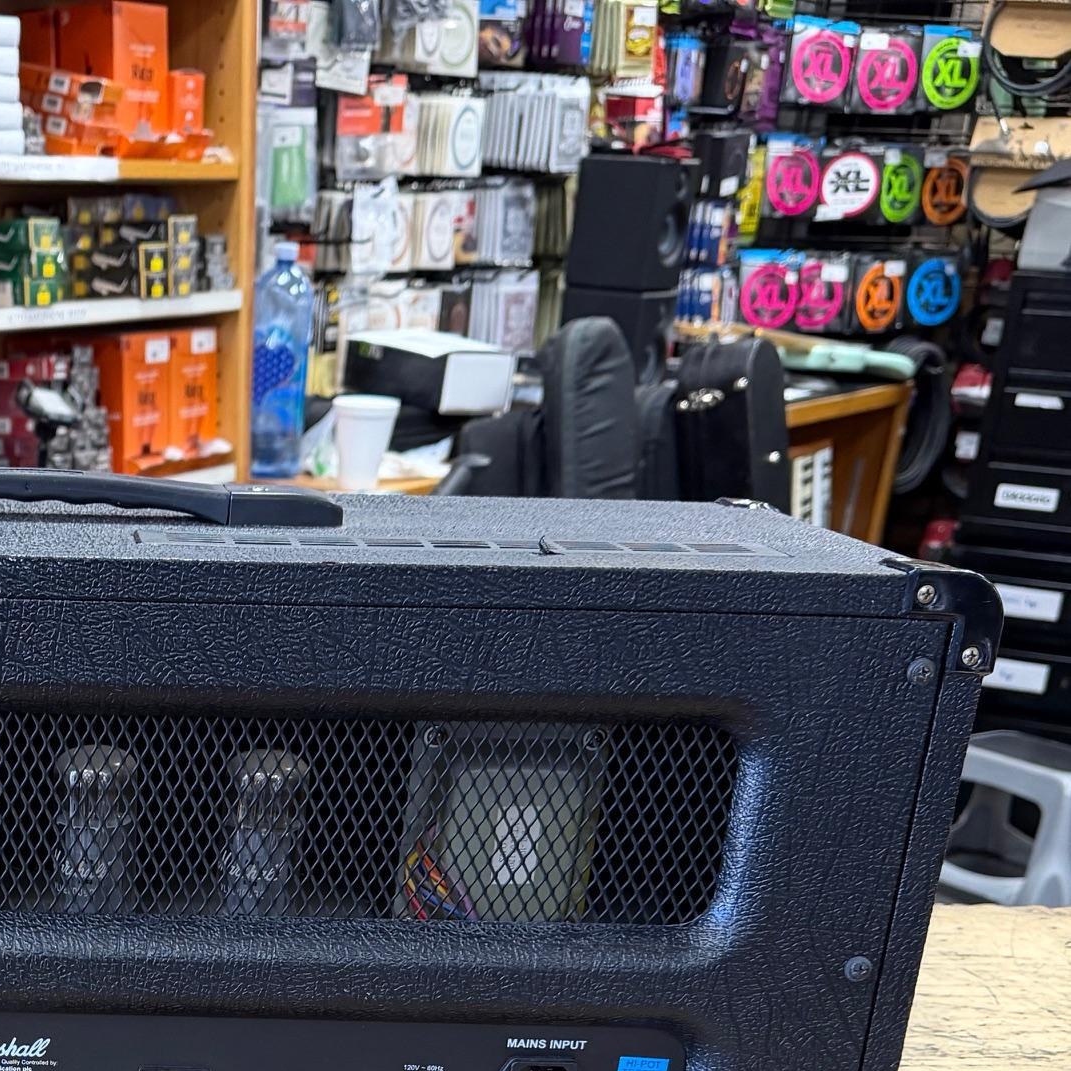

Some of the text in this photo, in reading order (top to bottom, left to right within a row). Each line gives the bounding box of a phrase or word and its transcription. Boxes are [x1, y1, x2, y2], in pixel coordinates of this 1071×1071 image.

[803, 52, 839, 83] XL
[934, 58, 968, 89] XL
[832, 170, 870, 194] XL
[507, 1038, 588, 1050] MAINS INPUT
[625, 1059, 662, 1069] HI-POT
